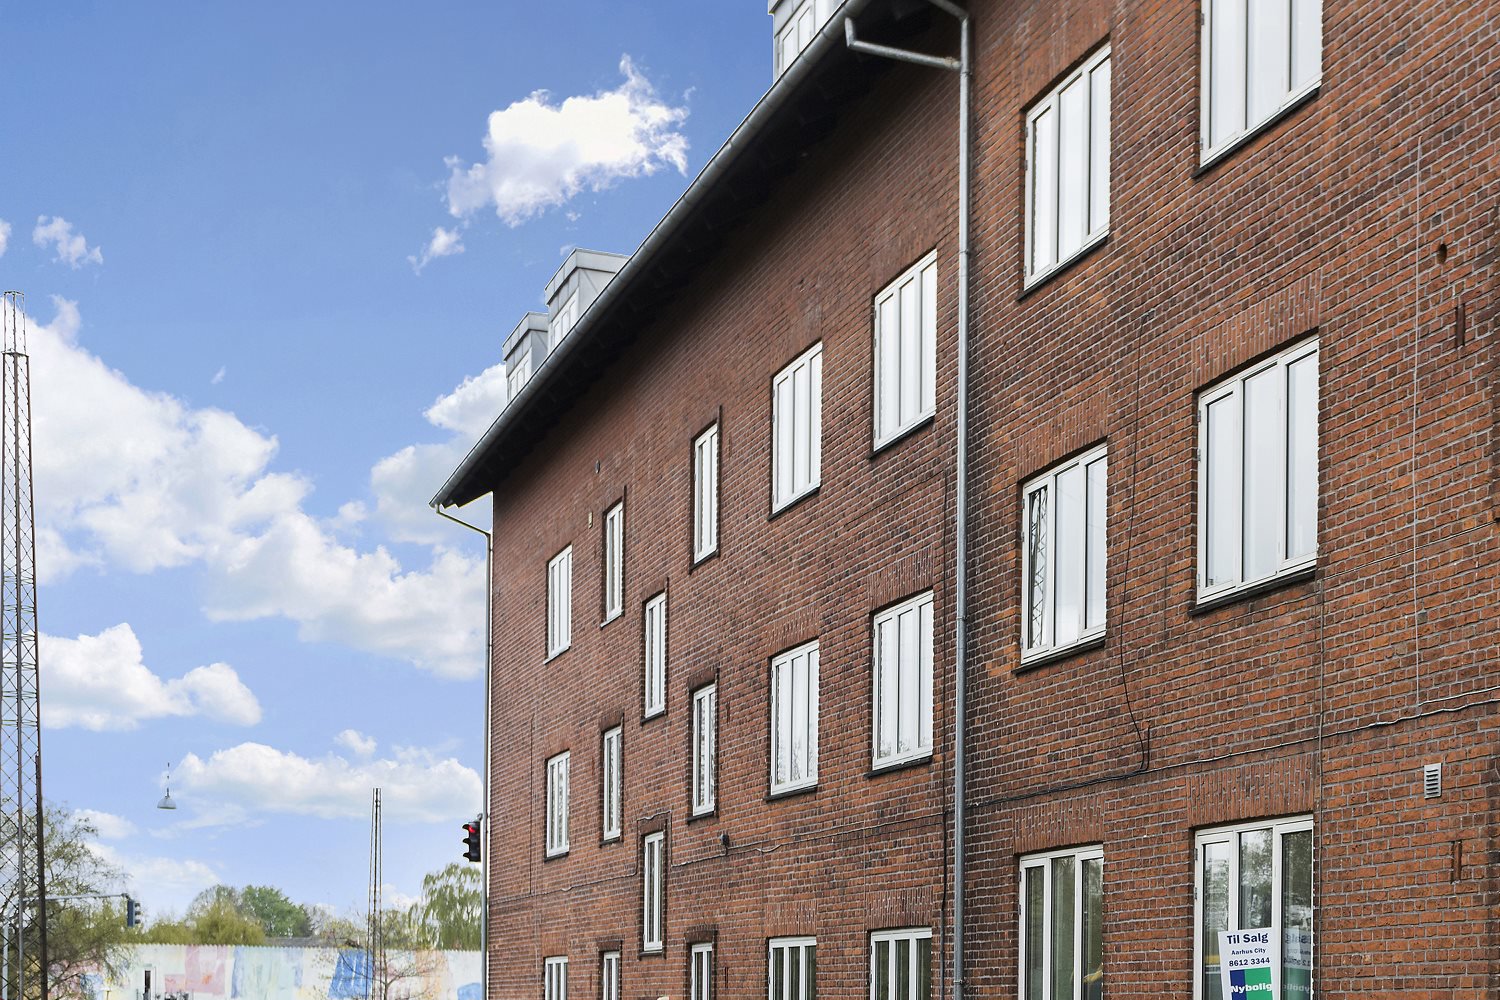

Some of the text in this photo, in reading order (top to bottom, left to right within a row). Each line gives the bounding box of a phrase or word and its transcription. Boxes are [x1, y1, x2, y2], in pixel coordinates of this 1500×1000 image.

[1227, 932, 1269, 944] Til Salg
[1229, 957, 1270, 967] 8612 3344
[1231, 982, 1272, 993] Nybolig
